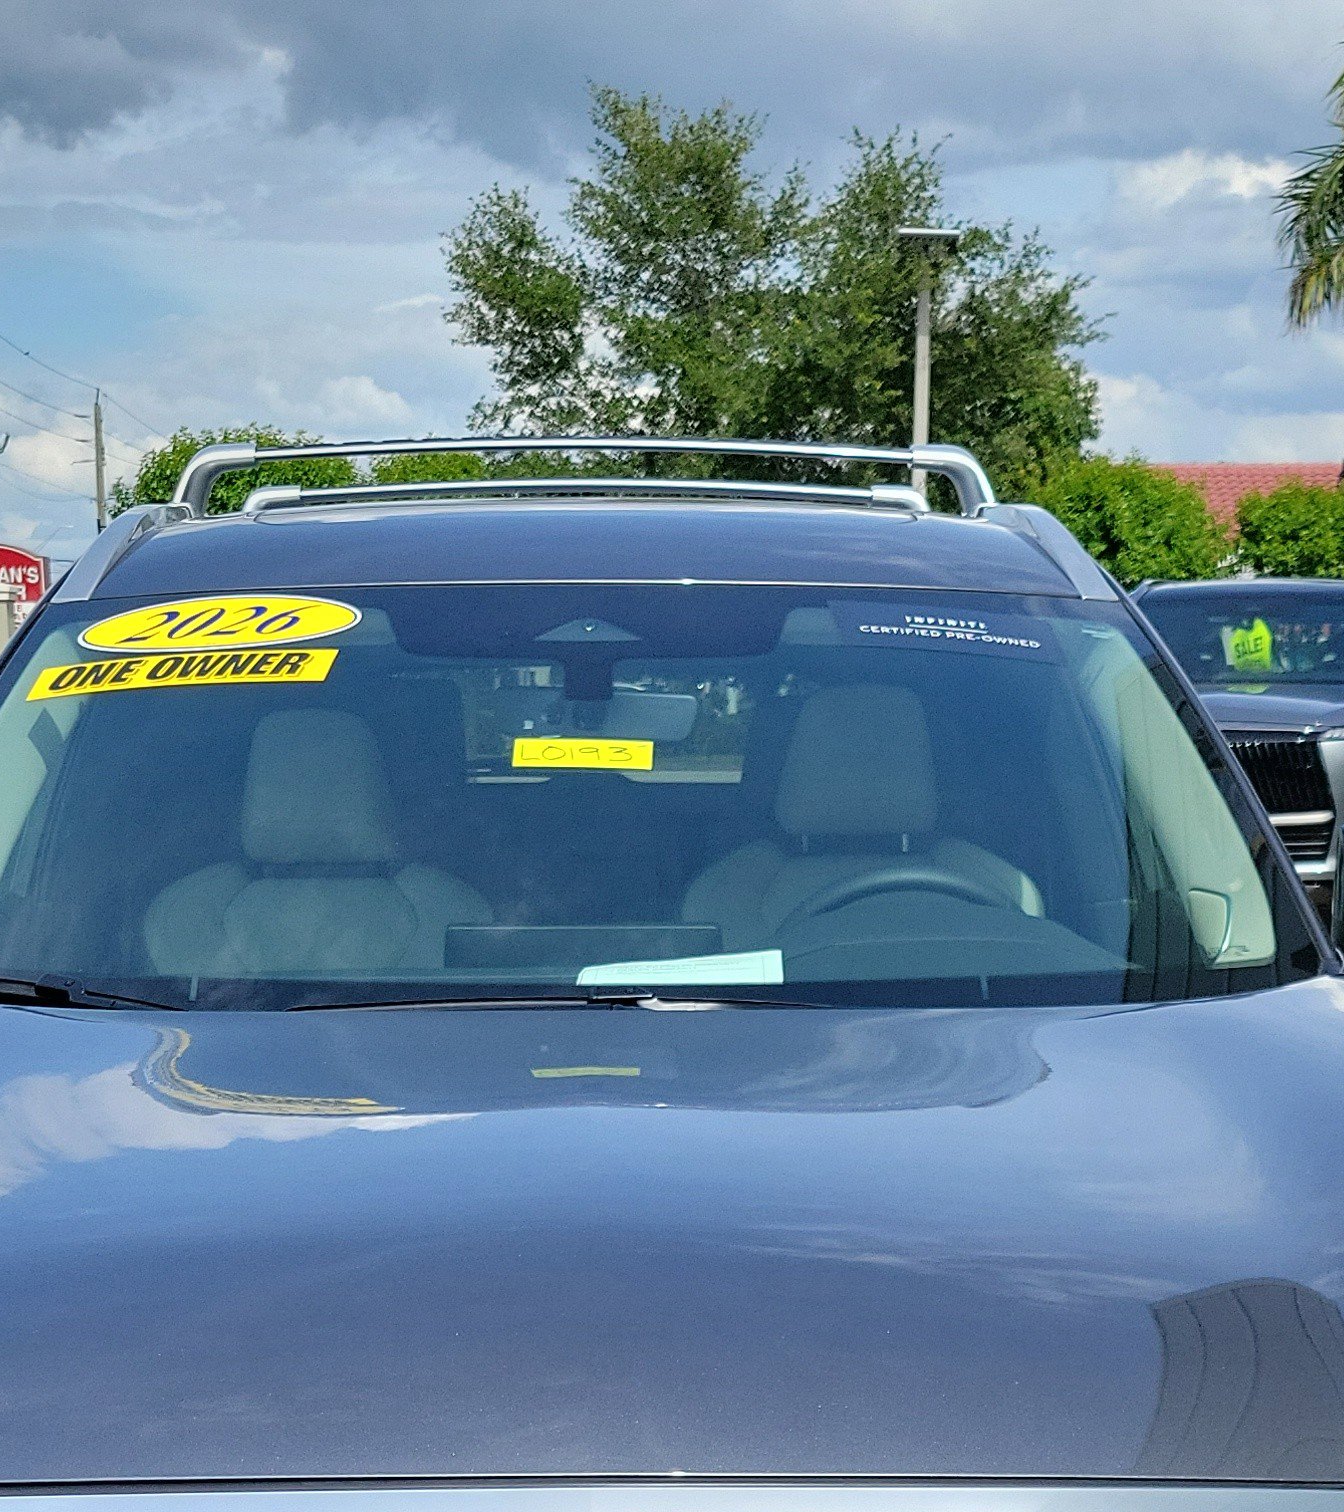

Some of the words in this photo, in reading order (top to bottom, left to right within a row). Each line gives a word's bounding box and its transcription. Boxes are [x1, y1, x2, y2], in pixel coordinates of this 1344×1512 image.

[114, 605, 323, 646] 2026
[859, 625, 943, 638] CERTIFIED
[945, 630, 1042, 649] PRE-OWNED
[47, 659, 147, 694] ONE
[145, 651, 314, 682] OWNER
